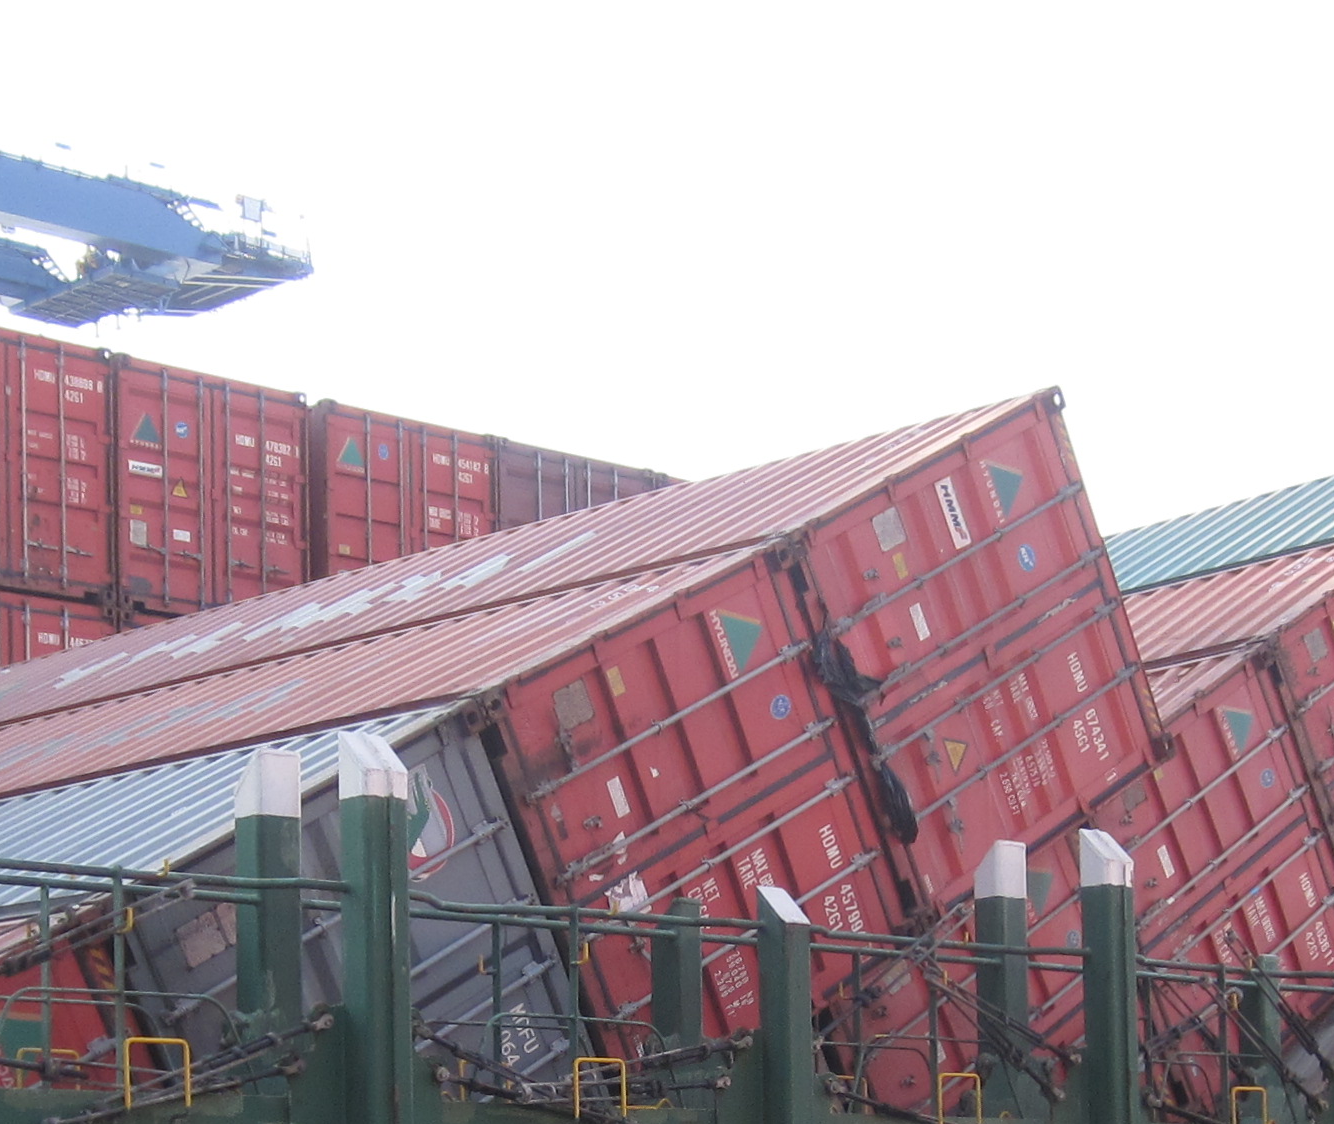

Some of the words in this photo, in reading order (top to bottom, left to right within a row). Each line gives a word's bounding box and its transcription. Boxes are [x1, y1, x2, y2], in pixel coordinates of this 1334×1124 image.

[1066, 652, 1087, 692] HDMU
[1072, 718, 1089, 752] 45G1
[736, 856, 756, 889] TARE
[749, 848, 767, 874] MAX
[703, 878, 719, 902] NET
[819, 824, 842, 868] HDMU
[839, 882, 863, 935] 45799
[823, 893, 843, 932] 42G1
